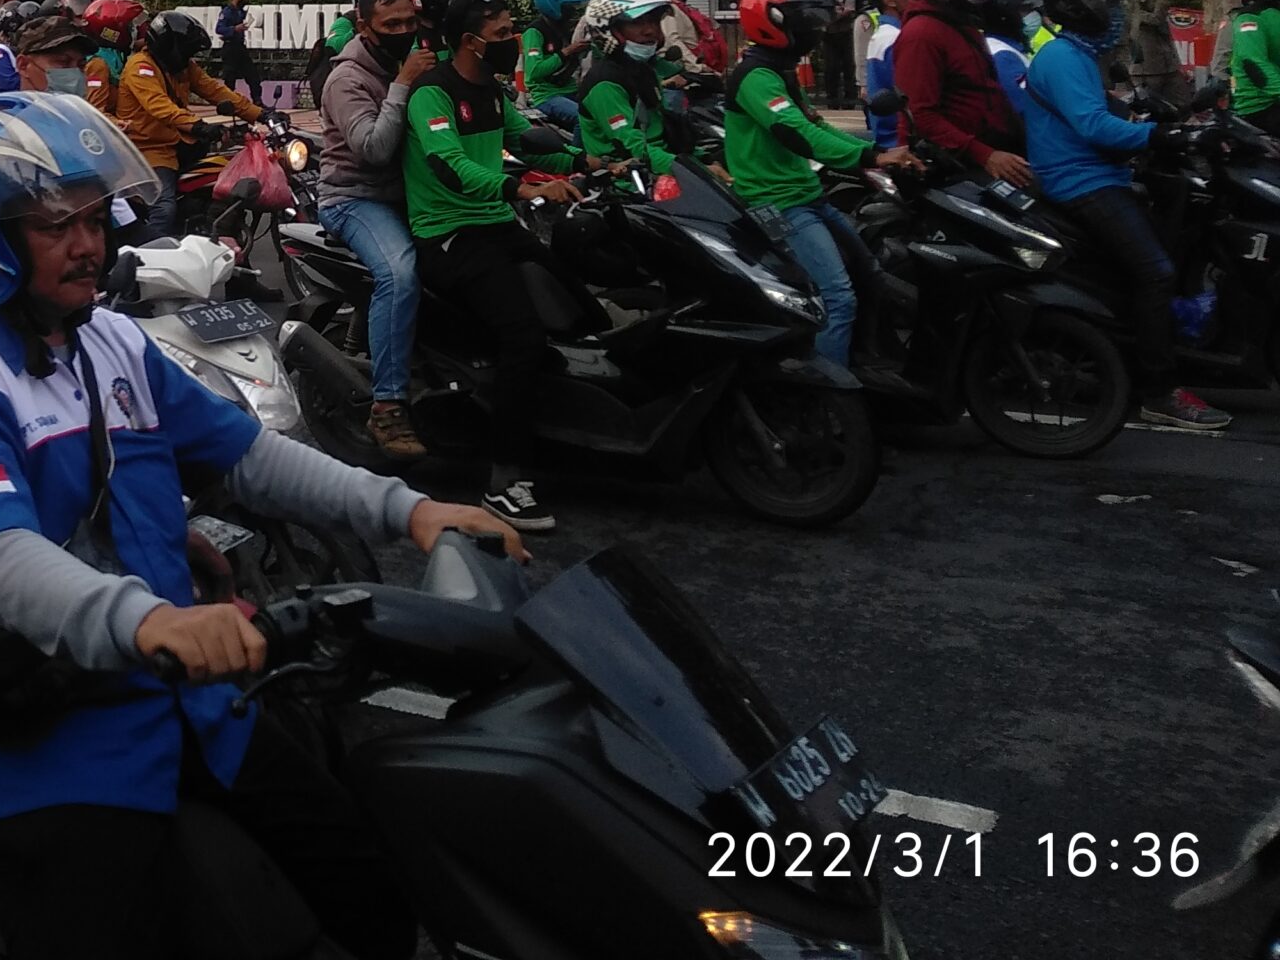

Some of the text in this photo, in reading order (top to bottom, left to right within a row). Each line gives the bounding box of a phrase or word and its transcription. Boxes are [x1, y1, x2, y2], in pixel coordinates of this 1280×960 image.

[181, 301, 258, 327] W 3135 LF
[729, 782, 777, 827] W
[773, 736, 832, 801] 6625
